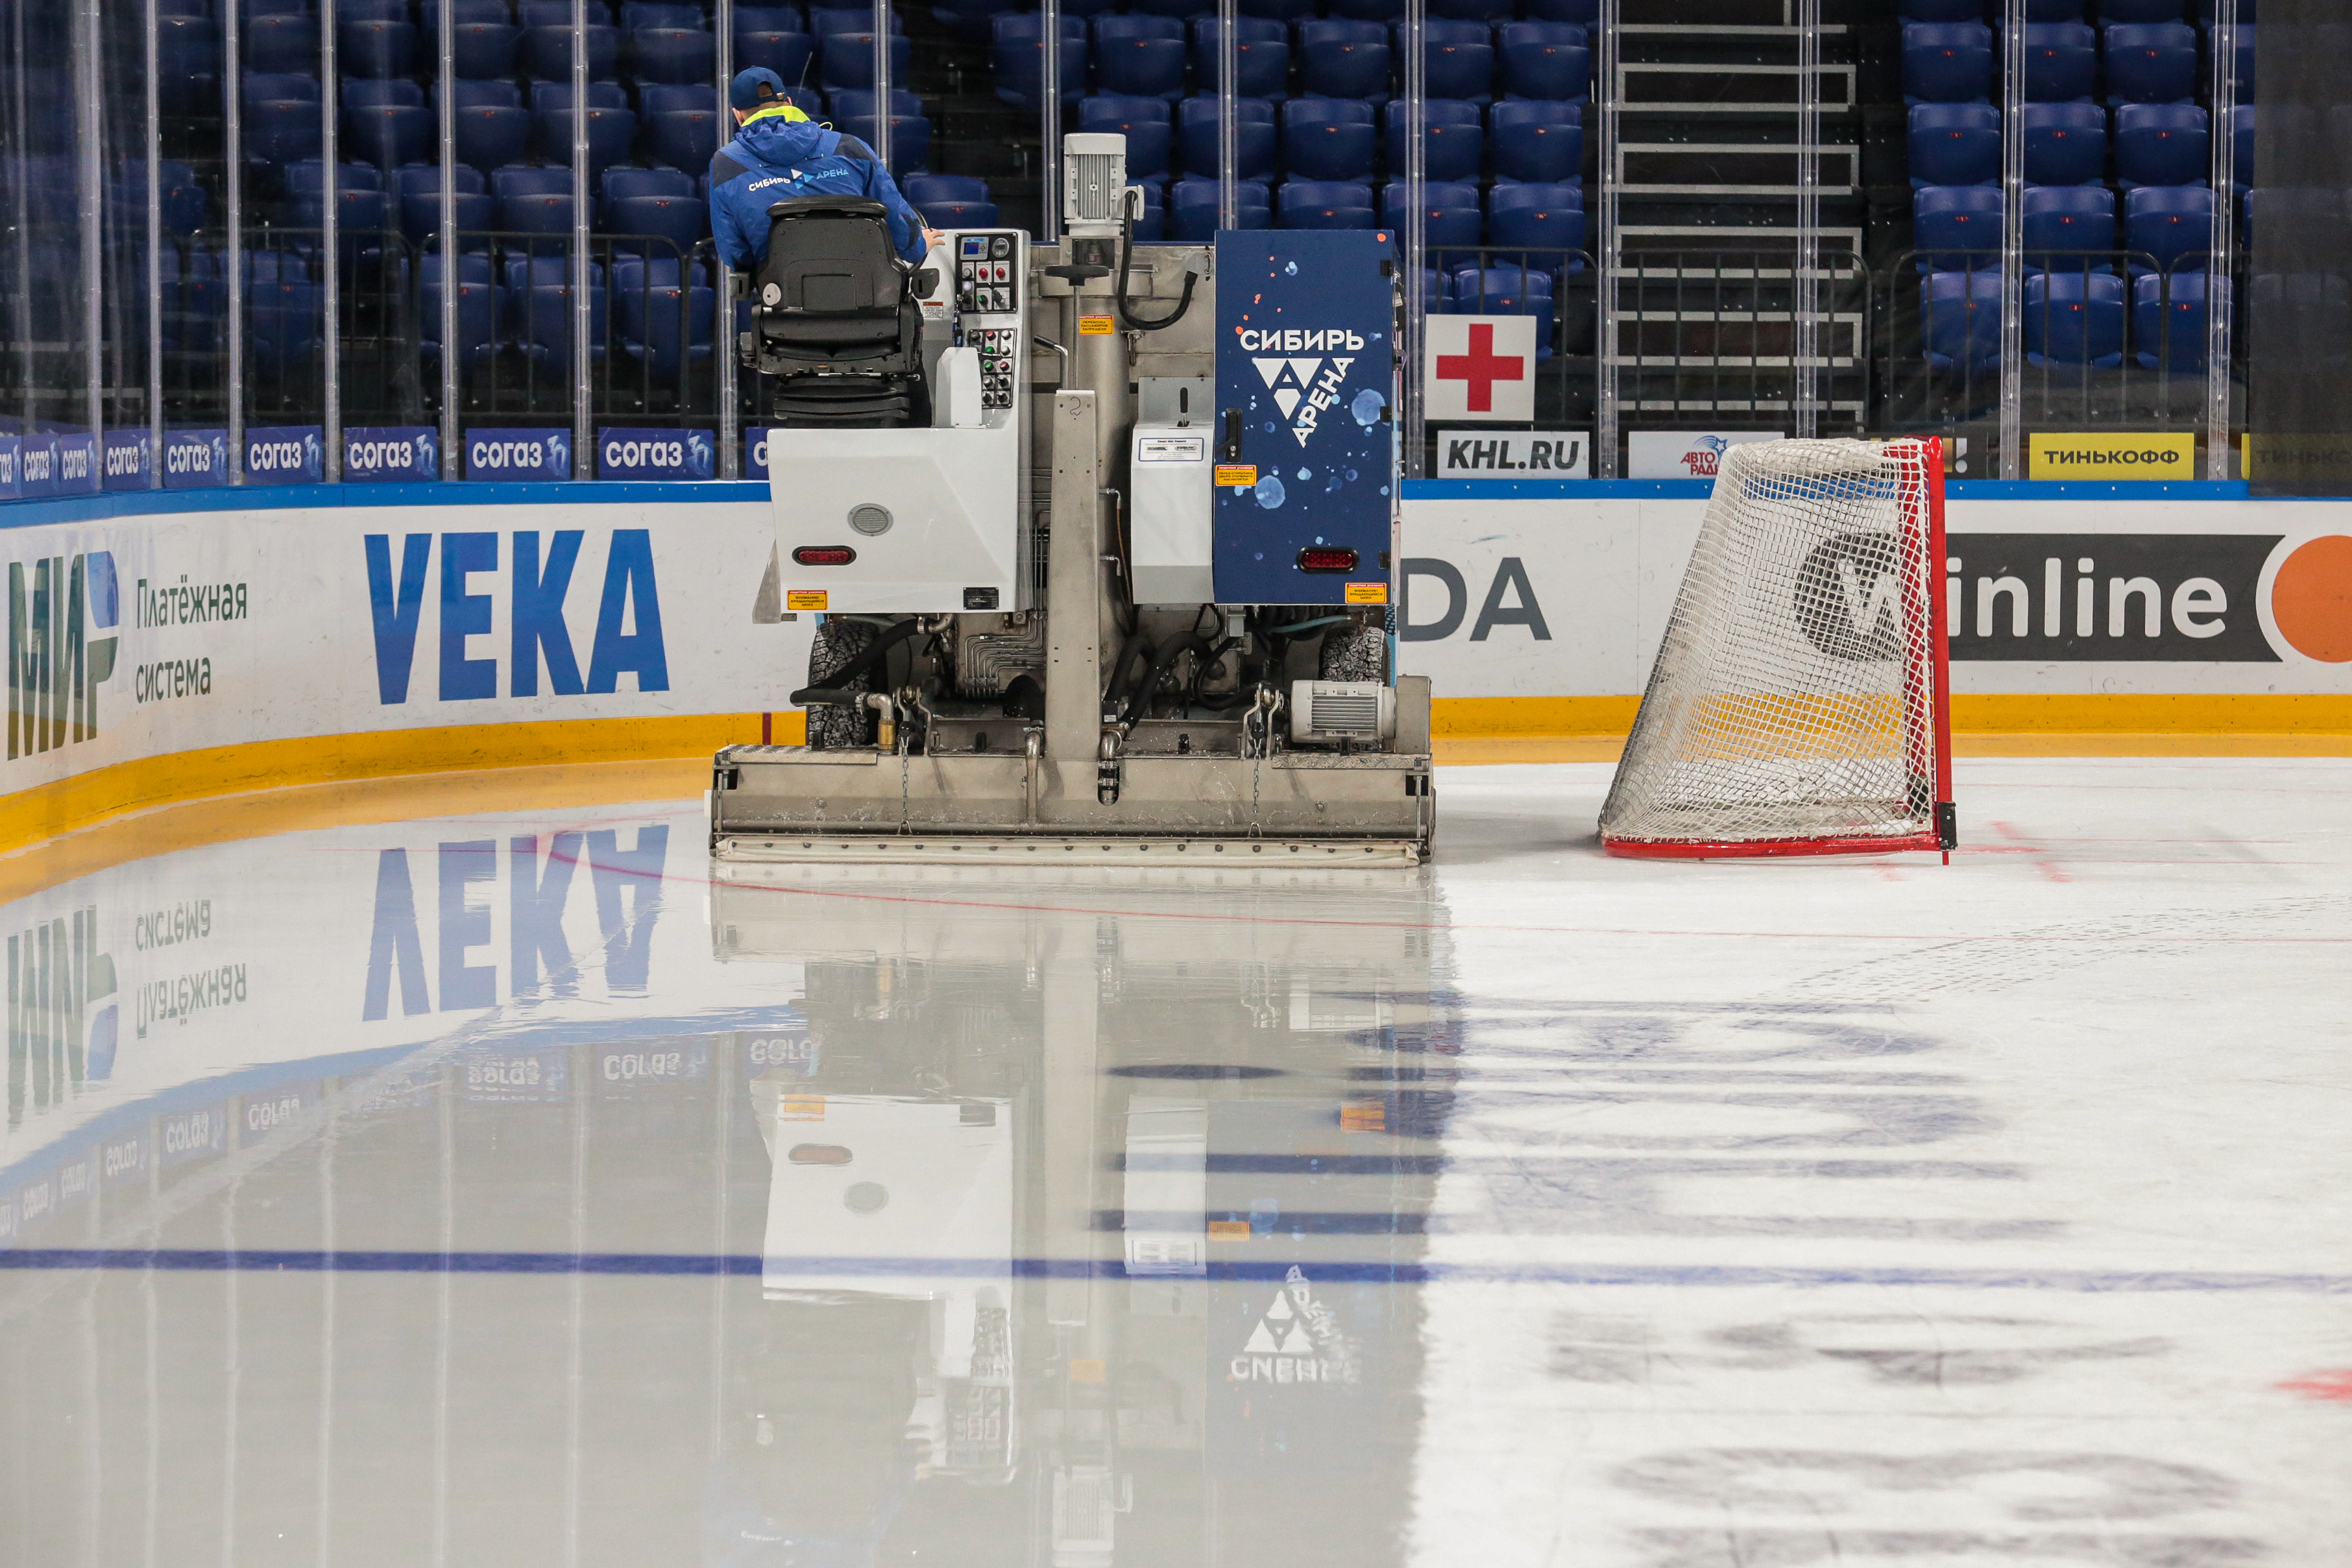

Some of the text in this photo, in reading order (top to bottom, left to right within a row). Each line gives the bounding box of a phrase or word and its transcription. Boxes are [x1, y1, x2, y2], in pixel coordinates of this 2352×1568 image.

[748, 168, 849, 192] СИБИРЬ АРЕНА
[1240, 330, 1364, 351] СИБИРЬ
[1292, 357, 1355, 448] АРЕНА
[1447, 439, 1580, 470] KHL.RU
[1680, 452, 1716, 464] АВТО
[2044, 448, 2181, 466] ТИНЬКОФФ
[137, 575, 247, 629] Платёжная
[364, 529, 670, 705] VEKA
[7, 550, 119, 761] МИР
[136, 657, 211, 704] система
